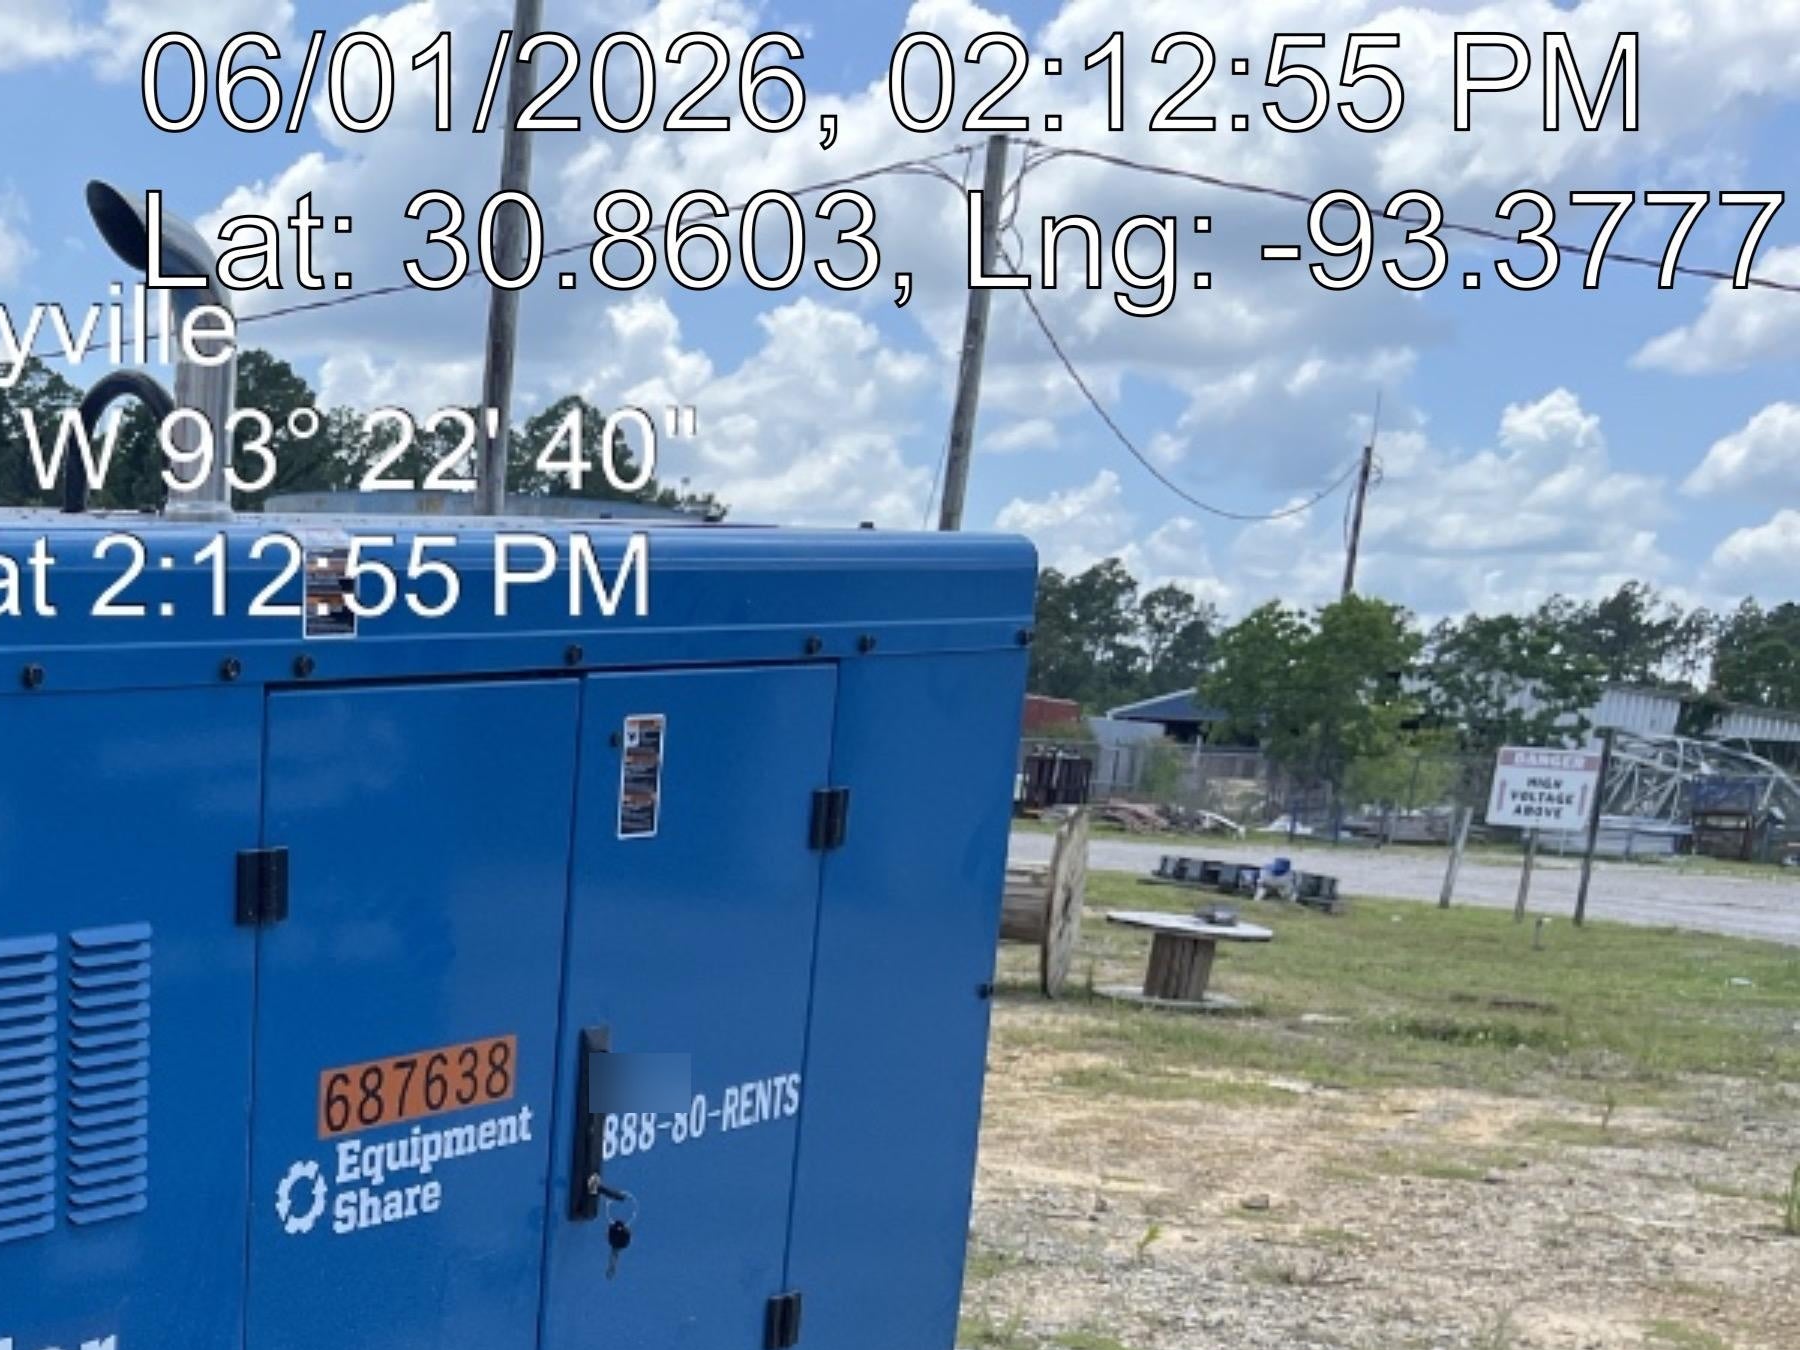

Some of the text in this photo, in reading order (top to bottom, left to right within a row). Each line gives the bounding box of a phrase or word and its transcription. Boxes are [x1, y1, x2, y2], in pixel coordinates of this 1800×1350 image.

[1513, 752, 1585, 770] DANGER
[1513, 804, 1563, 820] ABOVE
[324, 1041, 512, 1132] 687638
[335, 1105, 533, 1185] Equipment
[332, 1180, 442, 1235] Share
